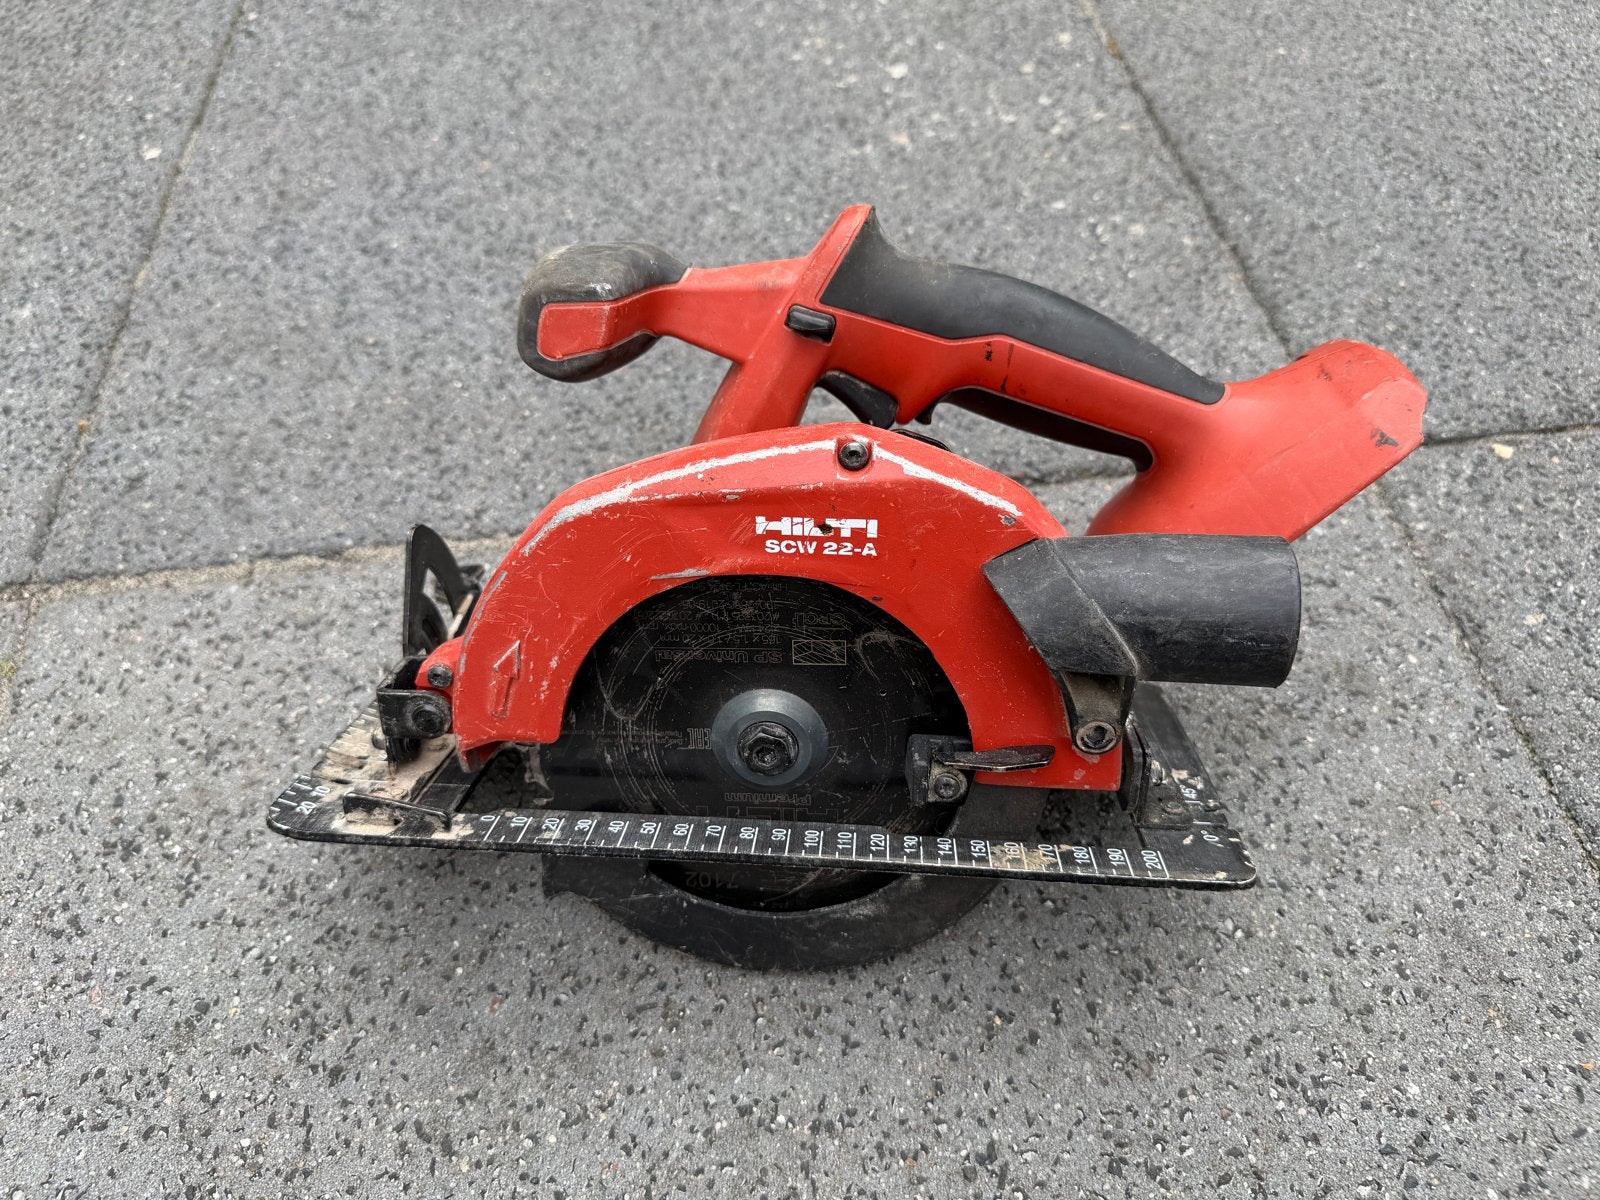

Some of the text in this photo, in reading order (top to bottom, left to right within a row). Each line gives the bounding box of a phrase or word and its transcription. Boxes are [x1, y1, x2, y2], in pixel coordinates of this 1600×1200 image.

[755, 516, 878, 538] HILTI
[765, 539, 878, 556] SCW 22-A
[654, 649, 783, 664] SP Universal
[724, 792, 811, 806] Premium
[510, 816, 528, 827] 10
[542, 817, 560, 830] 20
[575, 819, 592, 831] 30
[608, 820, 625, 833] 40
[640, 822, 657, 834] 50
[673, 823, 690, 836] 60
[705, 825, 722, 837] 70
[740, 826, 755, 839] 80
[771, 828, 787, 841] 90
[803, 830, 820, 848] 100
[837, 832, 853, 849] 110
[870, 833, 885, 851] 120
[903, 835, 918, 853] 130
[937, 837, 953, 856] 140
[970, 840, 987, 858] 150
[1004, 842, 1020, 859] 160
[1072, 846, 1089, 865] 180
[1107, 848, 1126, 866] 190
[1141, 850, 1160, 870] 200
